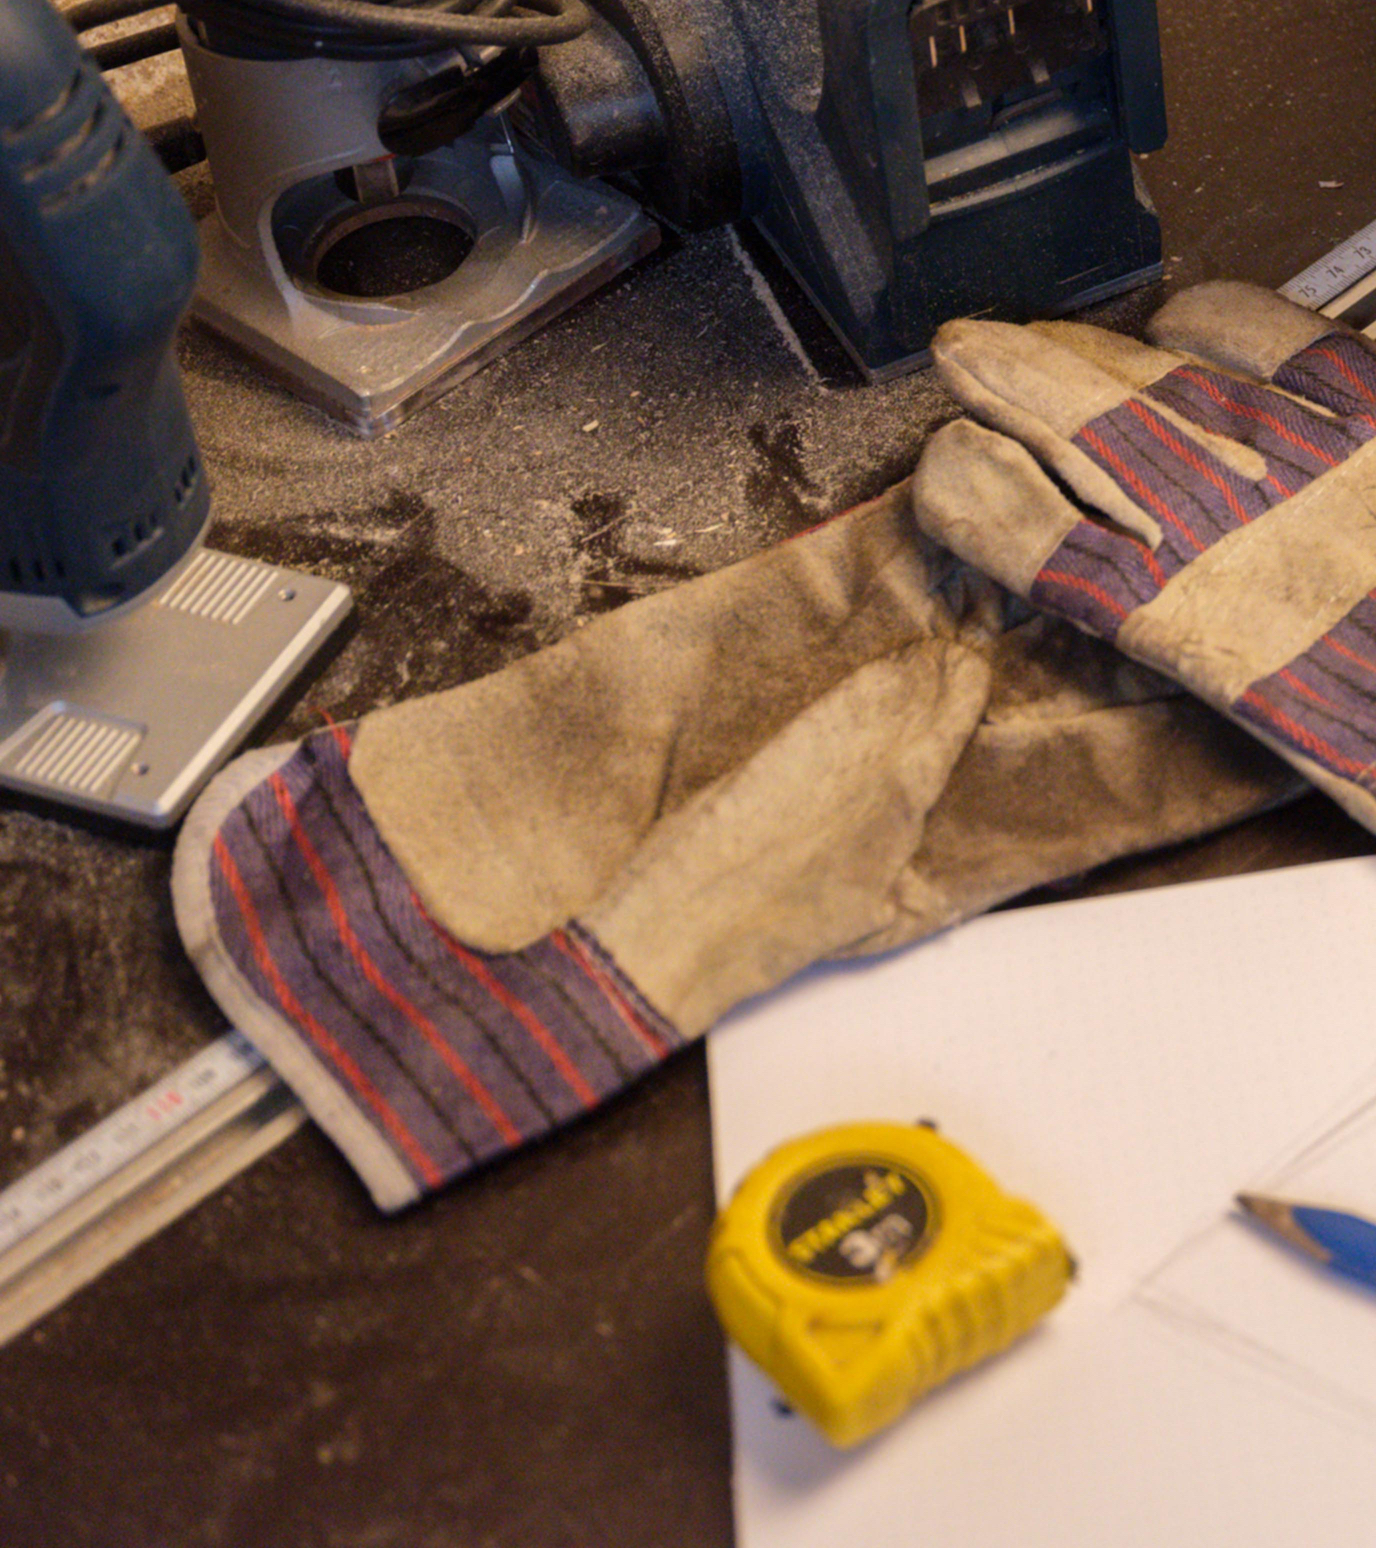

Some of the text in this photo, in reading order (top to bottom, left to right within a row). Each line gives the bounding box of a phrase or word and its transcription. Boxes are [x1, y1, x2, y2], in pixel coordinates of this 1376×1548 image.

[1299, 285, 1317, 298] 75
[1326, 265, 1344, 279] 74
[1353, 246, 1372, 260] 73
